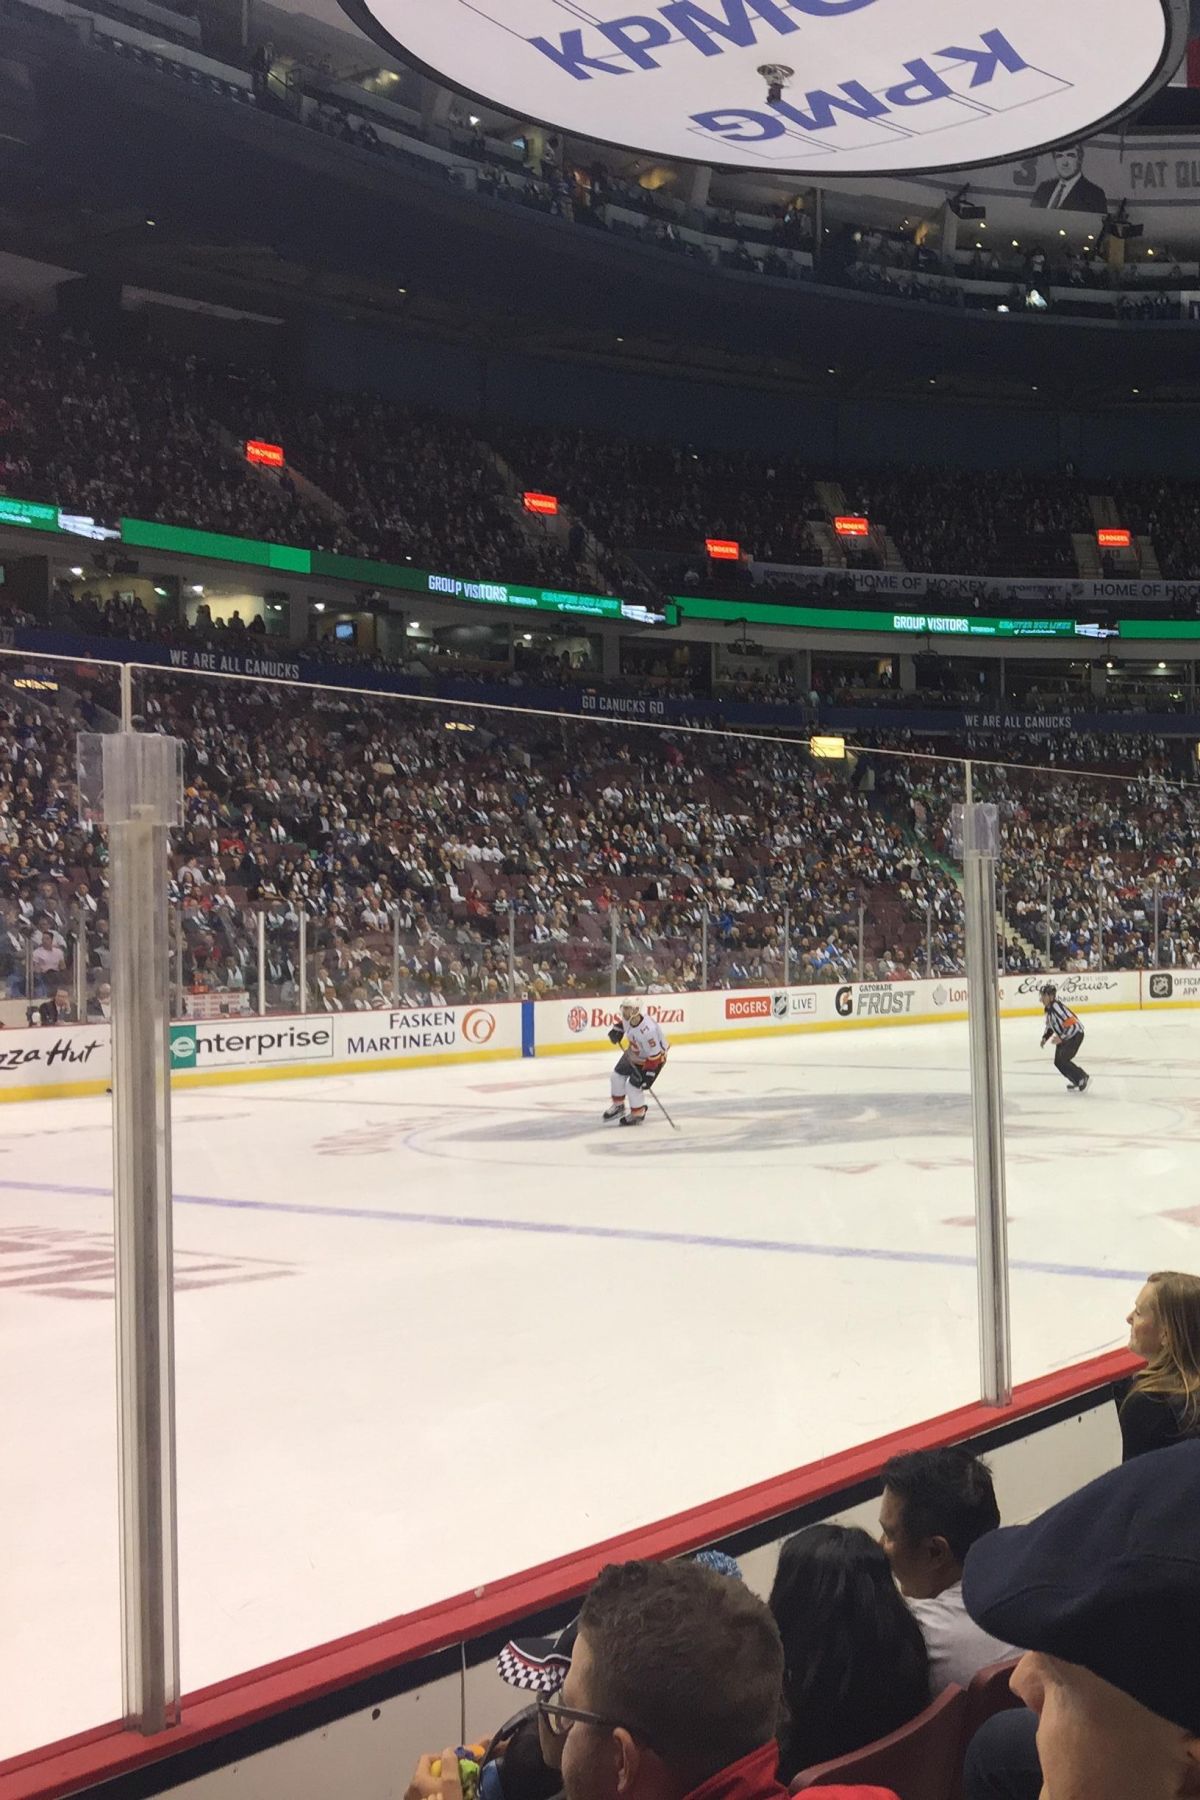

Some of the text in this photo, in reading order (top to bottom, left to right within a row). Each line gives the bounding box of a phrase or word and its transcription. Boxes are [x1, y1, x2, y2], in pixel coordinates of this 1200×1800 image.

[688, 28, 1028, 141] KPMG
[1130, 161, 1168, 189] PAT
[428, 575, 462, 596] GROUP
[464, 582, 508, 602] VISITORS
[852, 574, 898, 589] HOME
[902, 577, 922, 590] OF
[1093, 583, 1138, 596] HOME
[1142, 584, 1161, 596] OF
[893, 616, 926, 630] GROUP
[927, 617, 969, 632] VISITORS
[170, 649, 300, 680] WE ARE ALL CANUCKS
[582, 695, 665, 715] GO CANUCKS GO
[964, 715, 1072, 728] WE ARE ALL CANUCKS
[859, 984, 892, 993] GATORADE
[1183, 987, 1198, 995] APP
[729, 998, 813, 1014] ROGERS LIVE
[856, 991, 915, 1016] FROST
[389, 1011, 455, 1030] FASKEN
[646, 1005, 685, 1024] Pizza
[170, 1026, 330, 1058] enterprise
[347, 1031, 455, 1054] MARTINEAU
[45, 1038, 105, 1067] Hut
